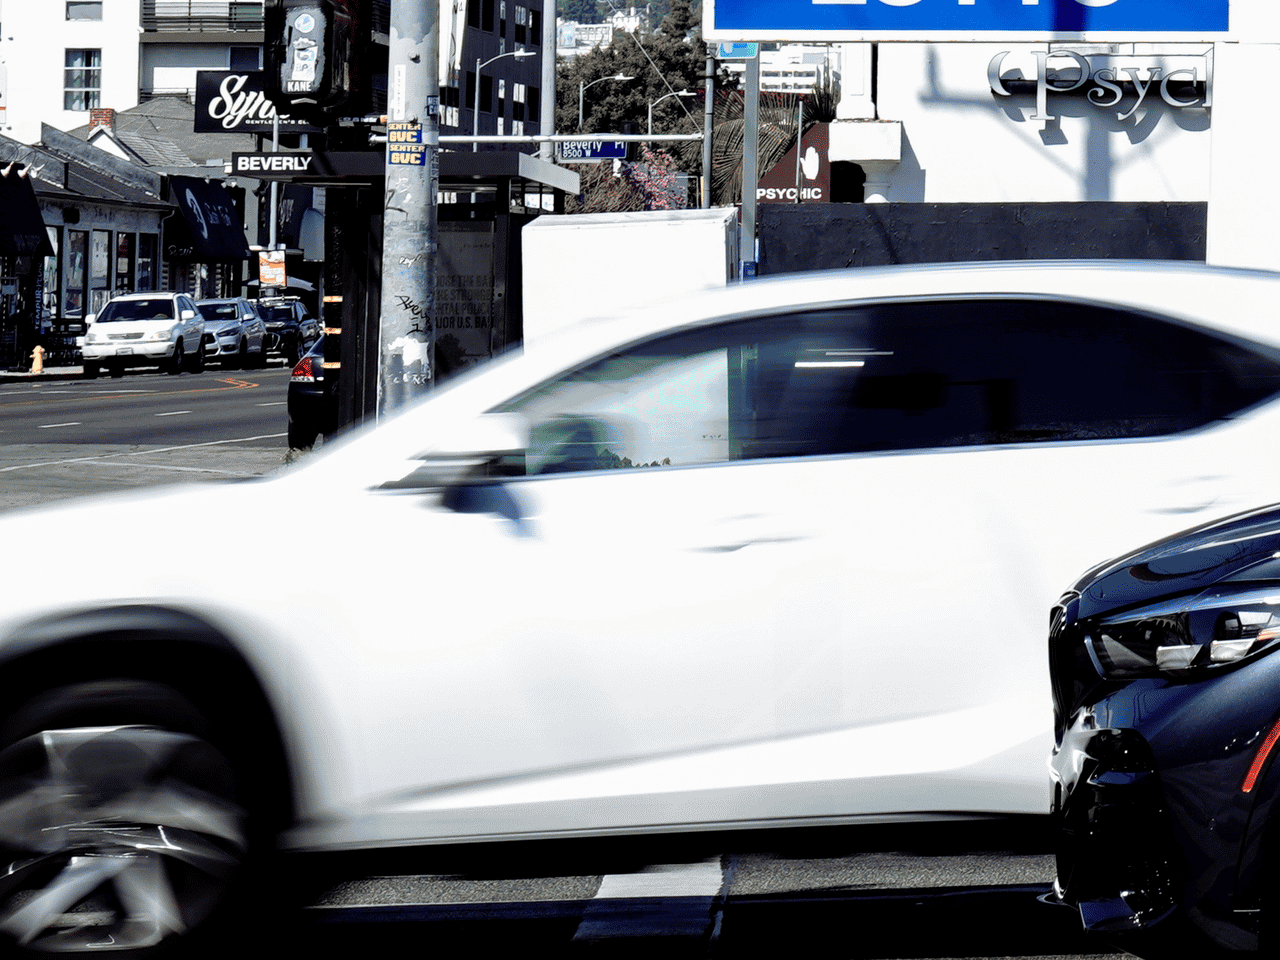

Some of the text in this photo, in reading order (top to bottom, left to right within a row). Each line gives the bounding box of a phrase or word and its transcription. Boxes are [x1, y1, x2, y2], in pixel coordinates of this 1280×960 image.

[287, 81, 312, 92] KANE
[562, 149, 582, 158] 8500
[237, 156, 312, 171] BEVERLY
[756, 187, 822, 200] PSYCHIC
